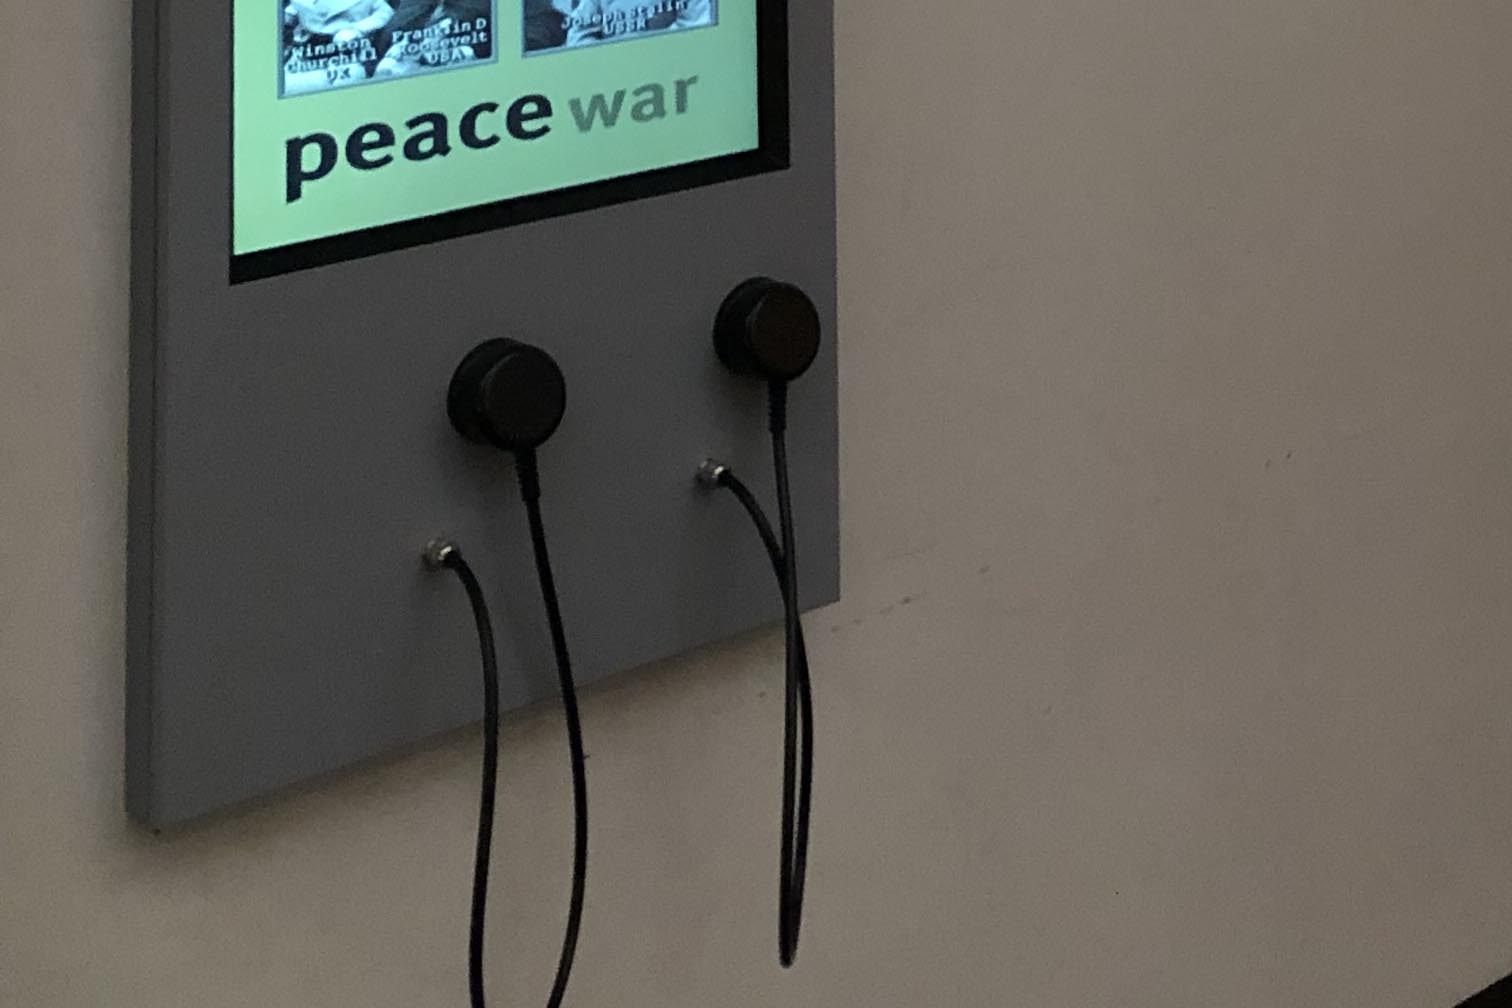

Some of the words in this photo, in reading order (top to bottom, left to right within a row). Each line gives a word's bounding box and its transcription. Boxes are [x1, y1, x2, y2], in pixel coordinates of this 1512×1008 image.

[475, 17, 488, 31] D
[285, 92, 553, 203] peace
[568, 75, 699, 134] war
